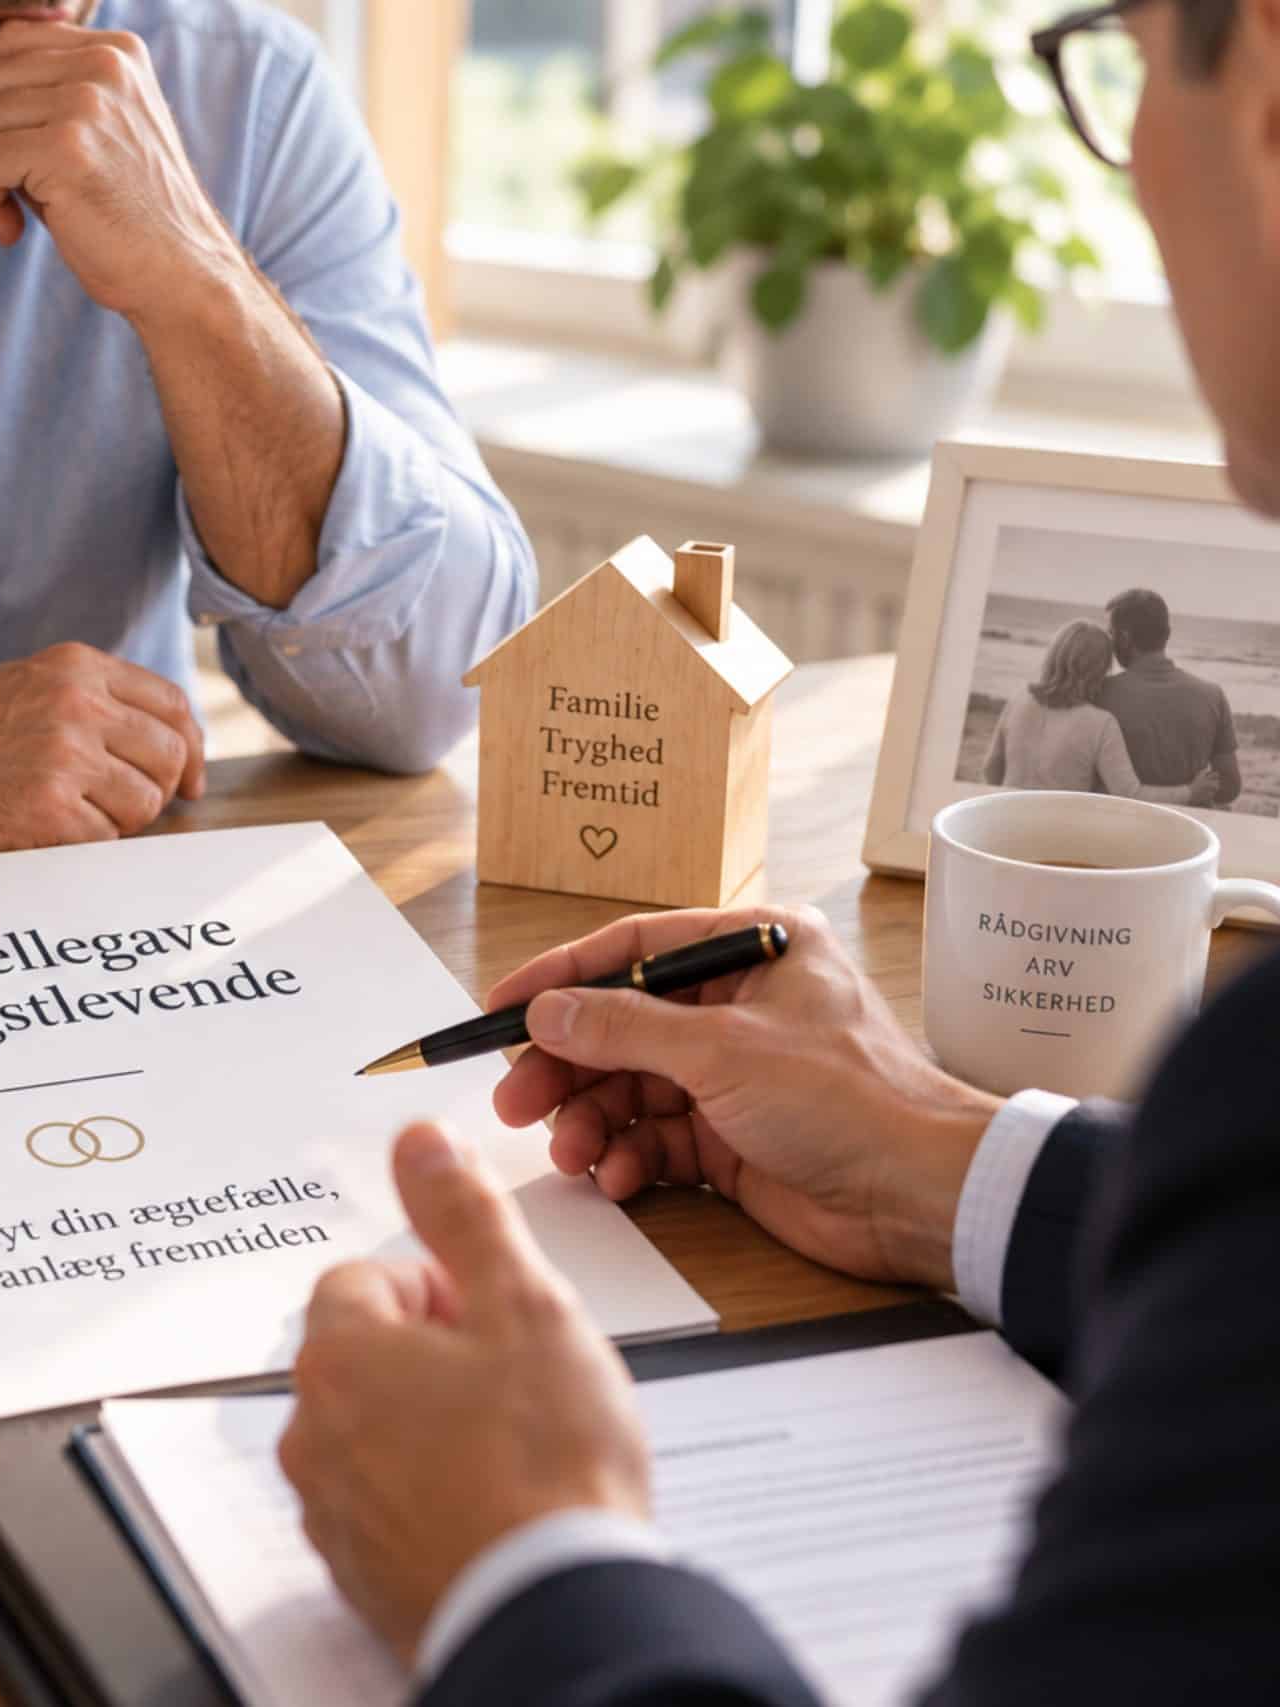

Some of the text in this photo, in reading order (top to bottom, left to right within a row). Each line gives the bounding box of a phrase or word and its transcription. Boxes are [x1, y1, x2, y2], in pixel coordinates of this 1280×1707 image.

[549, 685, 660, 722] Familie
[540, 726, 664, 766] Tryghed
[542, 770, 660, 808] Fremtid
[978, 912, 1132, 946] RÅDGIVNING
[1025, 956, 1074, 977] ARV
[983, 984, 1117, 1013] SIKKERHED
[51, 1208, 119, 1238] din
[129, 1176, 340, 1229] ægtefælle,
[129, 1221, 330, 1269] fremtiden
